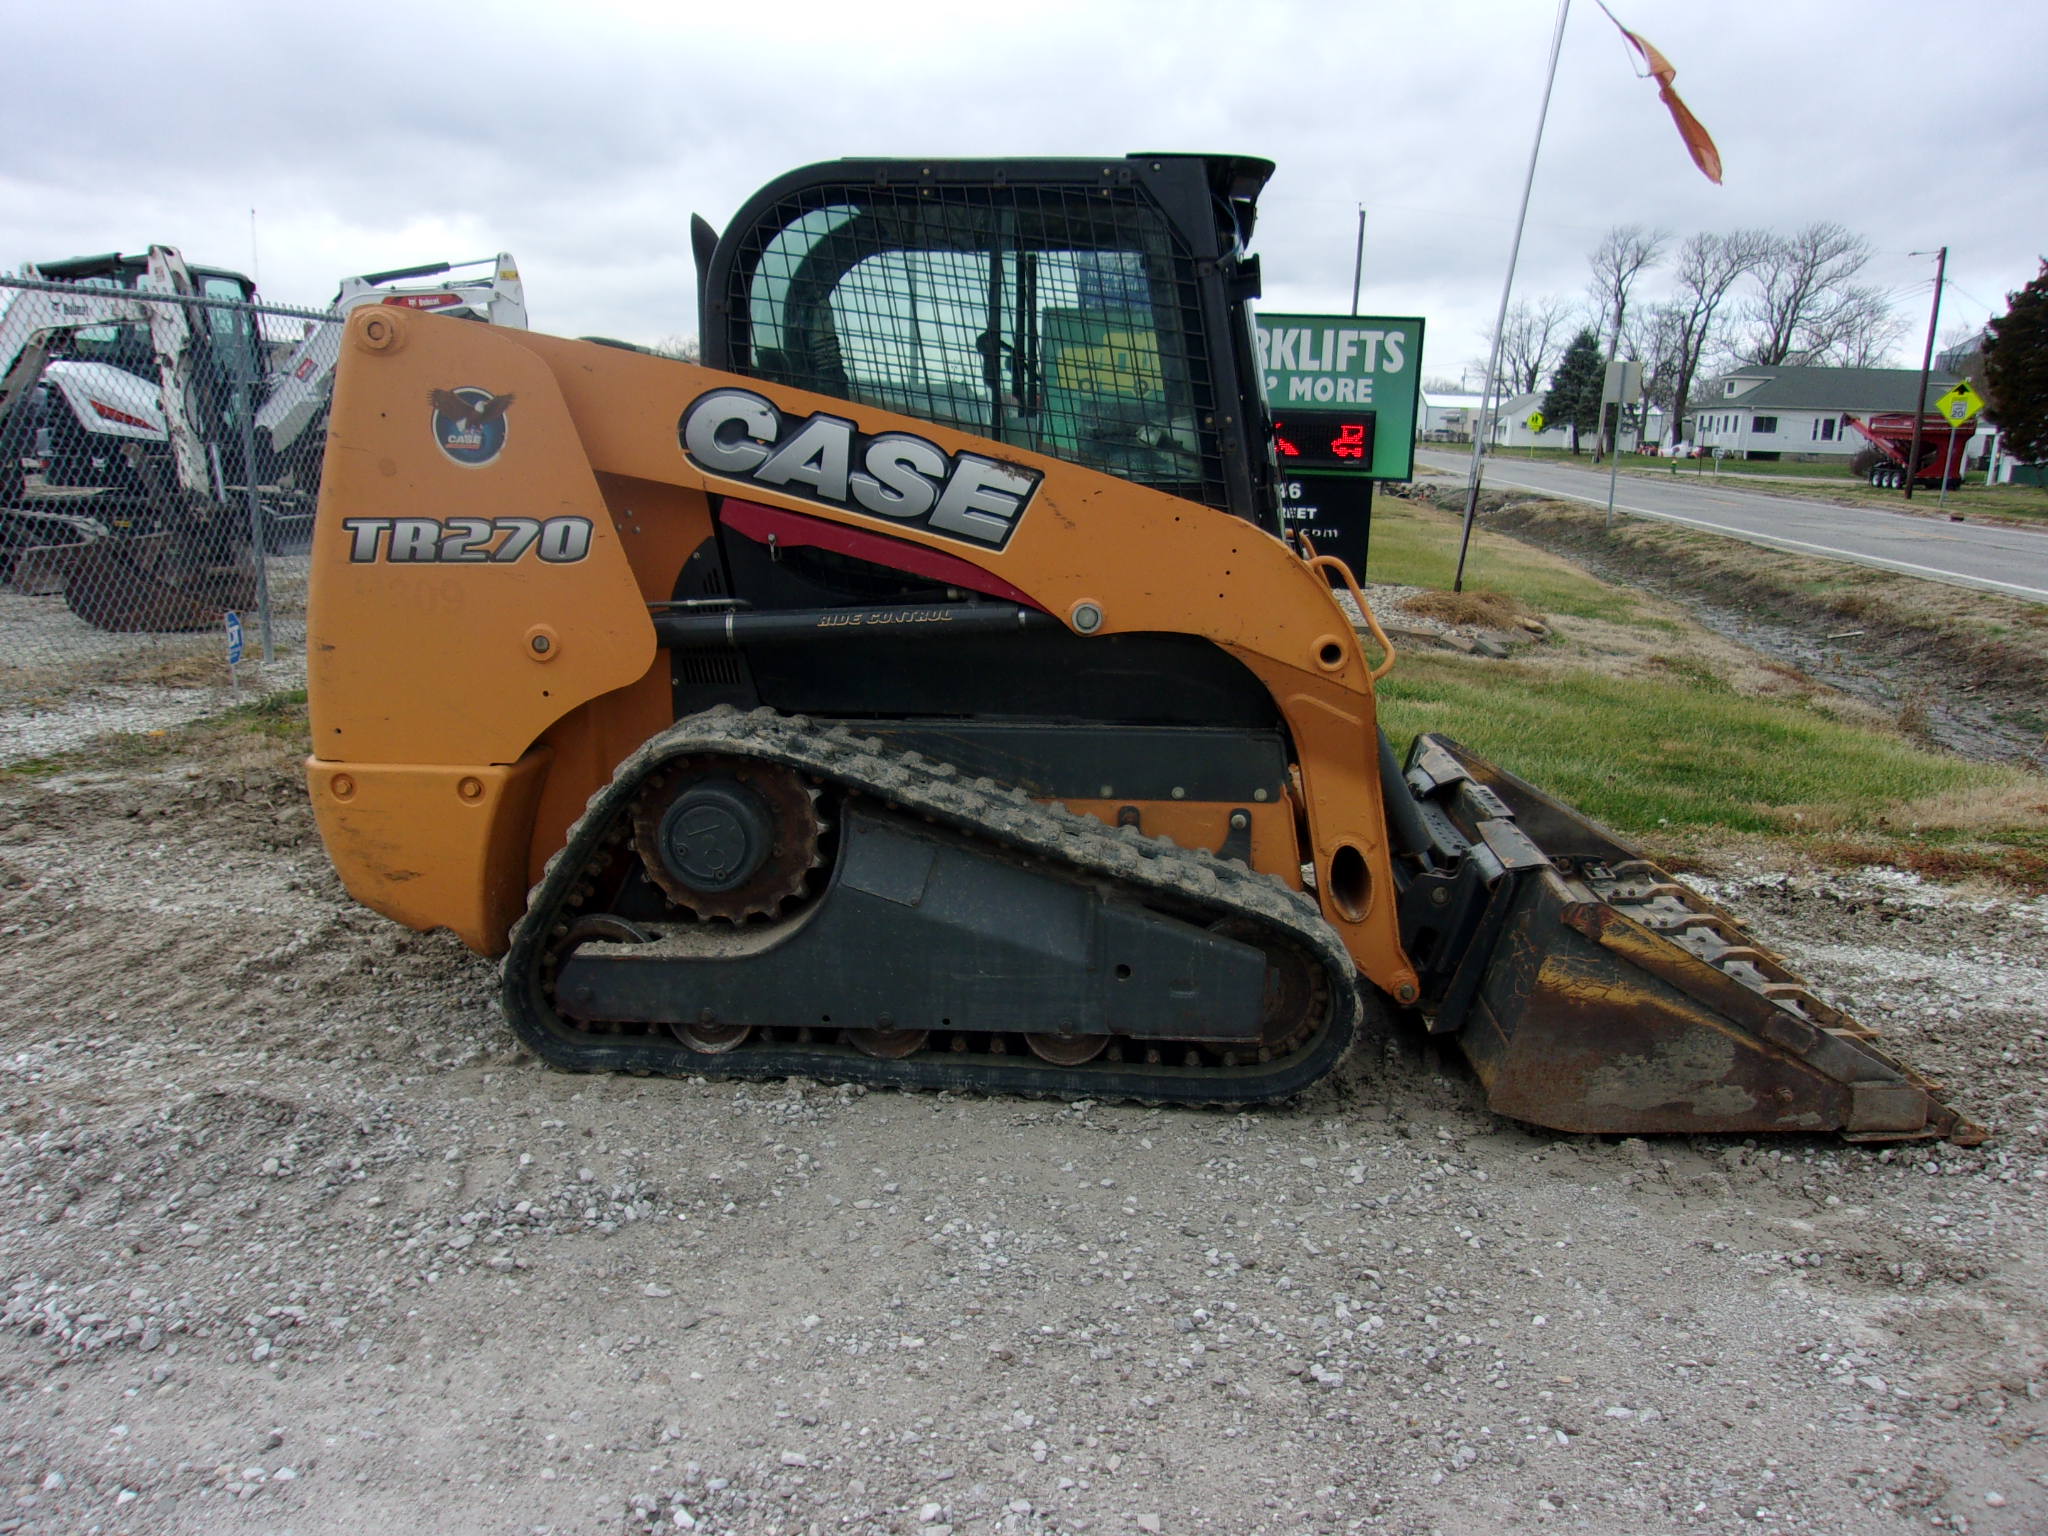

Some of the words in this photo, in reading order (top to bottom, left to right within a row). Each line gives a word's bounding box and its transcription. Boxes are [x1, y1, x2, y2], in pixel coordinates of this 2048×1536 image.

[1288, 376, 1374, 403] MORE
[679, 388, 1043, 549] CASE
[342, 516, 594, 564] TR270
